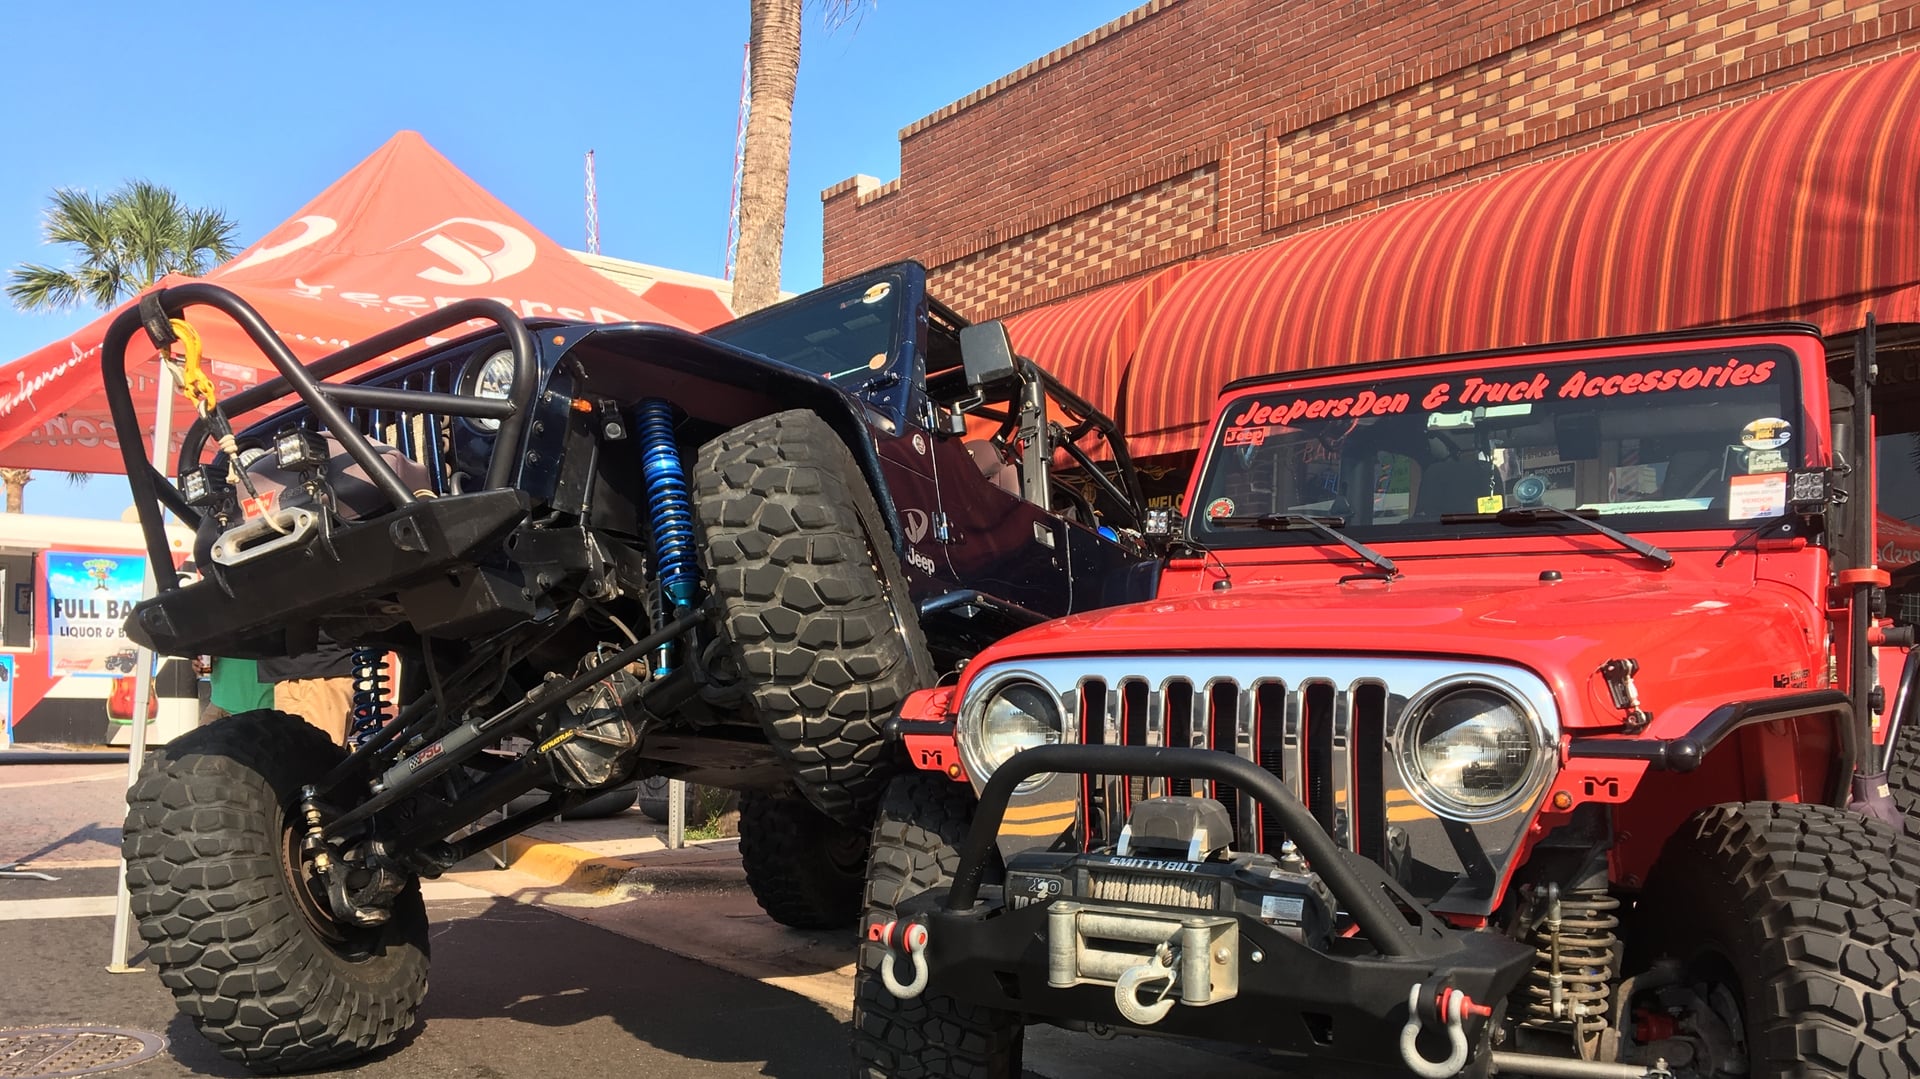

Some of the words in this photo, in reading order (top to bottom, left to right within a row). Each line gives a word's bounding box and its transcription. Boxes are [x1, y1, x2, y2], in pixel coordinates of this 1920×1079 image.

[1235, 390, 1410, 427] JeepersDen
[1421, 383, 1450, 410] &
[1458, 373, 1550, 404] Truck
[1558, 358, 1776, 399] Accessories
[1227, 429, 1263, 444] Jeep
[906, 547, 936, 576] Jeep
[54, 598, 100, 619] FULL
[106, 598, 140, 619] BA
[60, 626, 102, 637] LIQUOR
[105, 627, 115, 637] &
[540, 729, 574, 752] DYNATRAC
[1109, 857, 1200, 873] SMITTYBILT
